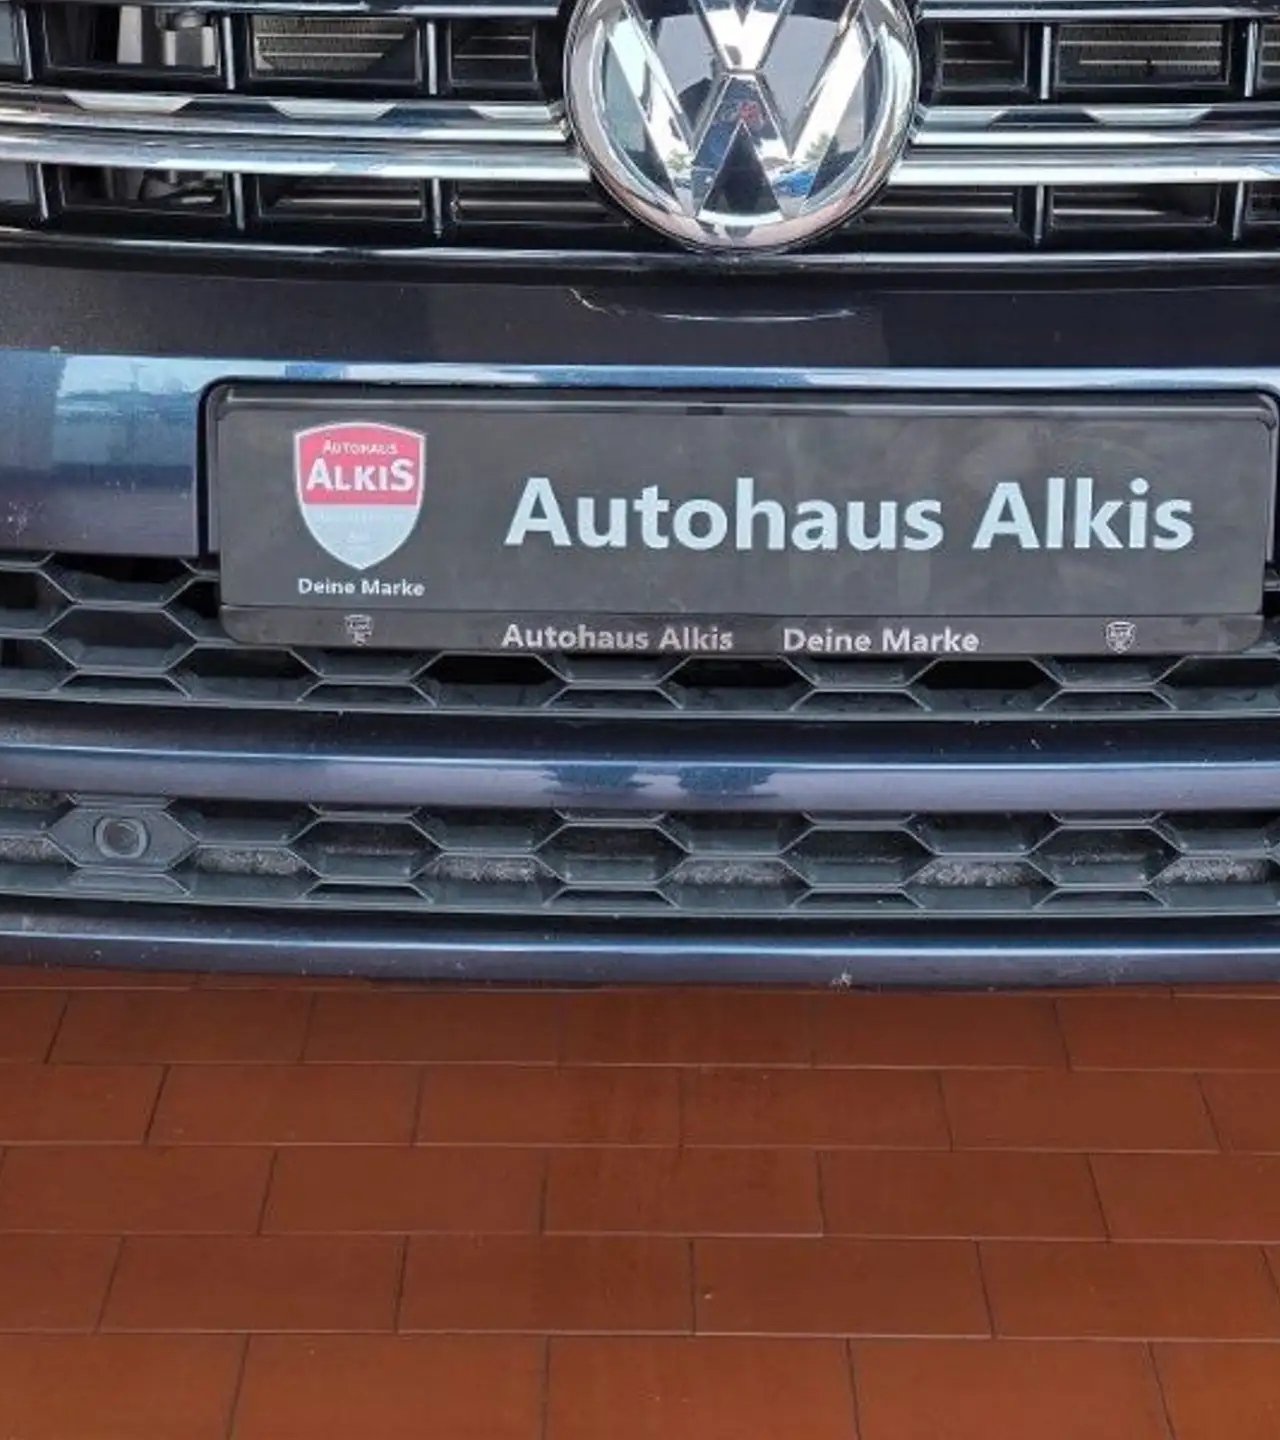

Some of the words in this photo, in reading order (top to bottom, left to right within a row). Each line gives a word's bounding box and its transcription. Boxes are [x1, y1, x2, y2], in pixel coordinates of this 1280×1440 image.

[323, 439, 398, 455] AUTOHAUS
[306, 458, 415, 492] ALKIS
[504, 476, 943, 551] Autohaus
[972, 477, 1193, 551] Alkis
[298, 578, 356, 595] Deine
[361, 579, 426, 597] Marke
[501, 624, 648, 650] Autohaus
[658, 626, 734, 652] Alkis
[784, 628, 872, 653] Deine
[882, 628, 980, 653] Marke
